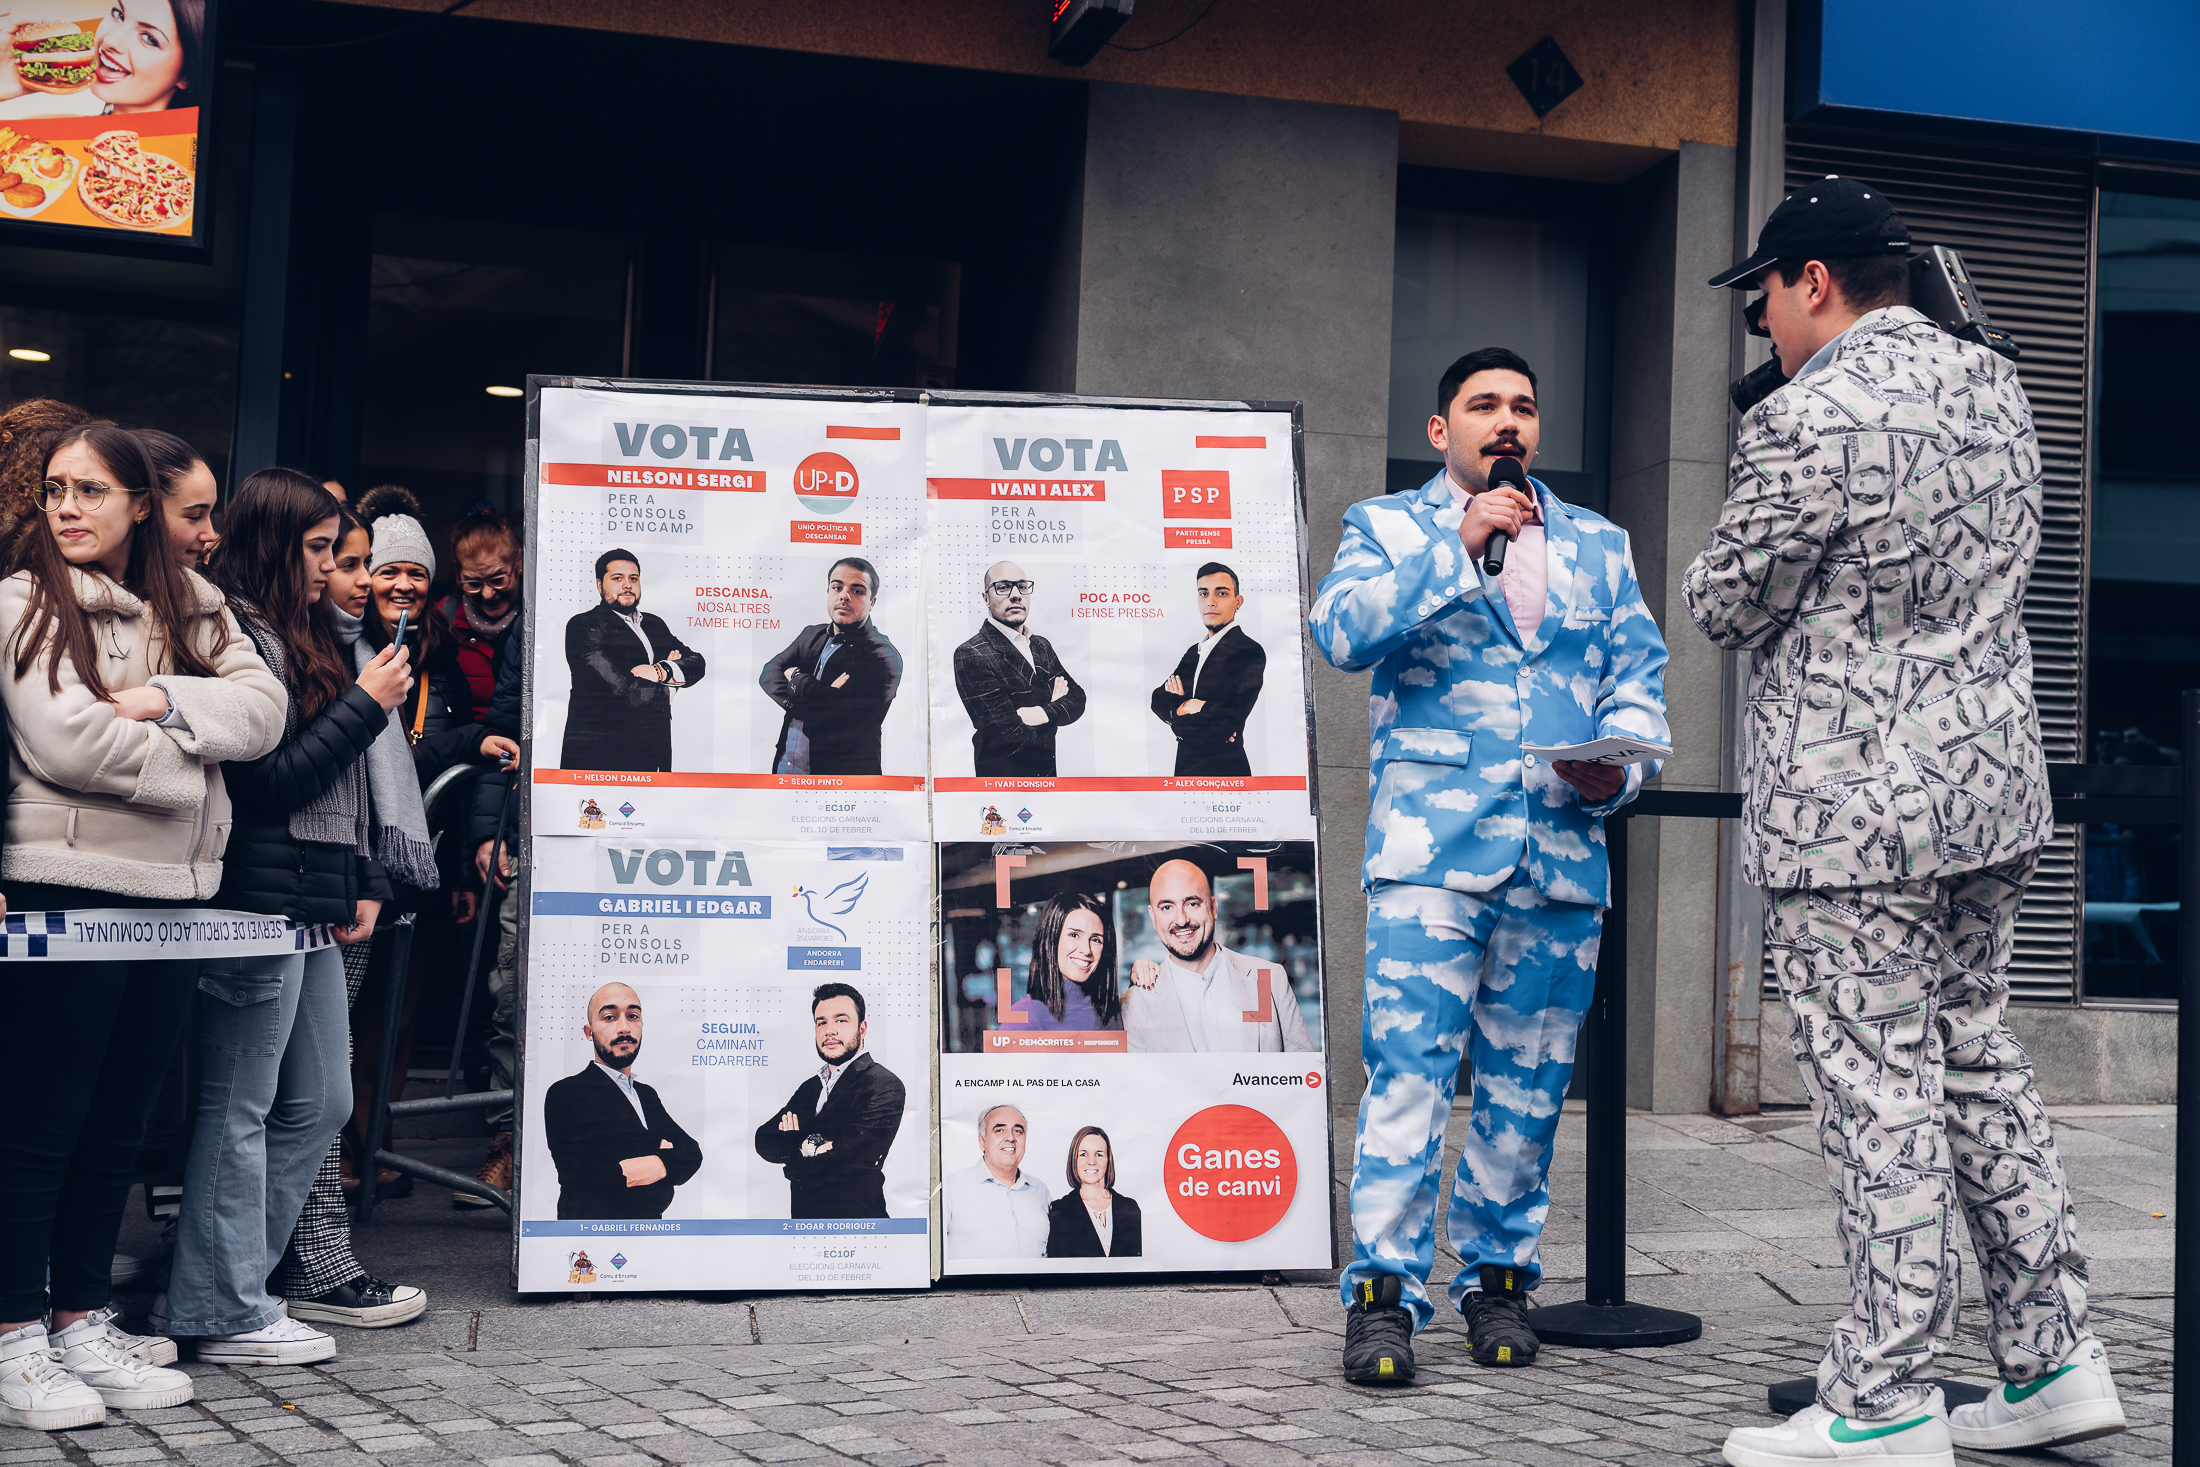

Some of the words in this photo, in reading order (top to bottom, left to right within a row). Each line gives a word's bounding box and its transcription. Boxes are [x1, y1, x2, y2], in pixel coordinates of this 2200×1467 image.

[1530, 58, 1566, 95] 14
[614, 422, 754, 462] VOTA
[993, 437, 1128, 472] VOTA
[607, 470, 684, 487] NELSON
[687, 473, 692, 486] I
[697, 473, 753, 489] SERGI
[991, 482, 1038, 496] IVAN
[1041, 483, 1046, 496] I
[1049, 483, 1095, 497] ALEX
[609, 493, 640, 504] PER
[646, 494, 655, 504] A
[608, 505, 686, 520] CÒNSOLS
[992, 506, 1020, 517] PER
[1027, 507, 1036, 517] A
[608, 520, 694, 534] D'ENCAMP
[817, 524, 848, 532] POLÍTICA
[992, 517, 1066, 531] CÒNSOLS
[806, 532, 847, 540] DESCANSAR
[992, 533, 1074, 544] D'ENCAMP
[695, 587, 772, 600] DESCANSA,
[1080, 592, 1107, 604] POC
[1111, 593, 1121, 604] A
[1123, 593, 1151, 604] POC
[697, 602, 771, 614] NOSALTRES
[1071, 608, 1075, 618] I
[1077, 607, 1115, 618] SENSE
[1118, 608, 1164, 619] PRESSA
[687, 613, 729, 628] TAMBÉ
[733, 617, 752, 628] HO
[755, 618, 780, 629] FEM
[573, 773, 582, 782] 1-
[584, 773, 618, 783] NELSON
[620, 774, 652, 783] DAMAS
[778, 777, 788, 785] 2-
[791, 777, 815, 786] SERGI
[817, 778, 843, 786] PINTO
[984, 780, 992, 788] 1-
[995, 780, 1015, 788] IVAN
[1017, 780, 1055, 788] DONSION
[1197, 779, 1244, 789] GONÇALVES
[792, 815, 837, 824] ELECCIONS
[839, 815, 881, 824] CARNAVAL
[1181, 816, 1223, 824] ELECCIONS
[1225, 816, 1265, 824] CARNAVAL
[800, 826, 815, 834] DEL
[818, 826, 827, 834] 10
[830, 826, 840, 834] DE
[843, 826, 872, 834] FEBRER
[1190, 826, 1204, 834] DEL
[1206, 826, 1215, 834] 10
[1217, 826, 1227, 834] DE
[1229, 826, 1258, 834] FEBRER
[607, 848, 752, 887] VOTA
[599, 898, 682, 914] GABRIEL
[686, 900, 691, 914] I
[696, 900, 763, 916] EDGAR
[74, 922, 153, 942] COMUNAL
[159, 921, 231, 948] CIRCULACIÓ
[233, 921, 244, 940] DE
[246, 920, 282, 939] SERVEI
[602, 923, 632, 935] PER
[640, 924, 650, 935] A
[601, 936, 682, 950] CÒNSOLS
[601, 952, 690, 965] D'ENCAMP
[701, 1022, 760, 1036] SEGUIM,
[696, 1038, 764, 1051] CAMINANT
[992, 1036, 1010, 1047] UP
[1019, 1036, 1074, 1046] DEMÒCRATES
[691, 1055, 768, 1067] ENDARRERE
[955, 1079, 962, 1087] A
[964, 1079, 1004, 1087] ENCAMP
[1012, 1079, 1024, 1087] AL
[1027, 1079, 1044, 1087] PAS
[1046, 1079, 1059, 1087] DE
[1061, 1079, 1073, 1087] LA
[1075, 1079, 1100, 1087] CASA
[1232, 1073, 1303, 1086] Avancem
[1177, 1144, 1281, 1171] Ganes
[1178, 1176, 1209, 1197] de
[1217, 1175, 1281, 1197] canvi
[591, 1223, 628, 1232] GABRIEL
[630, 1223, 681, 1232] FERNANDES
[783, 1223, 793, 1231] 2-
[795, 1222, 824, 1231] EDGAR
[827, 1222, 876, 1230] RODRIGUEZ
[789, 1263, 836, 1271] ELECCIONS
[839, 1262, 881, 1271] CARNAVAL
[798, 1274, 813, 1282] DEL
[816, 1274, 826, 1282] 10
[828, 1274, 839, 1282] DE
[842, 1273, 872, 1282] FEBRER
